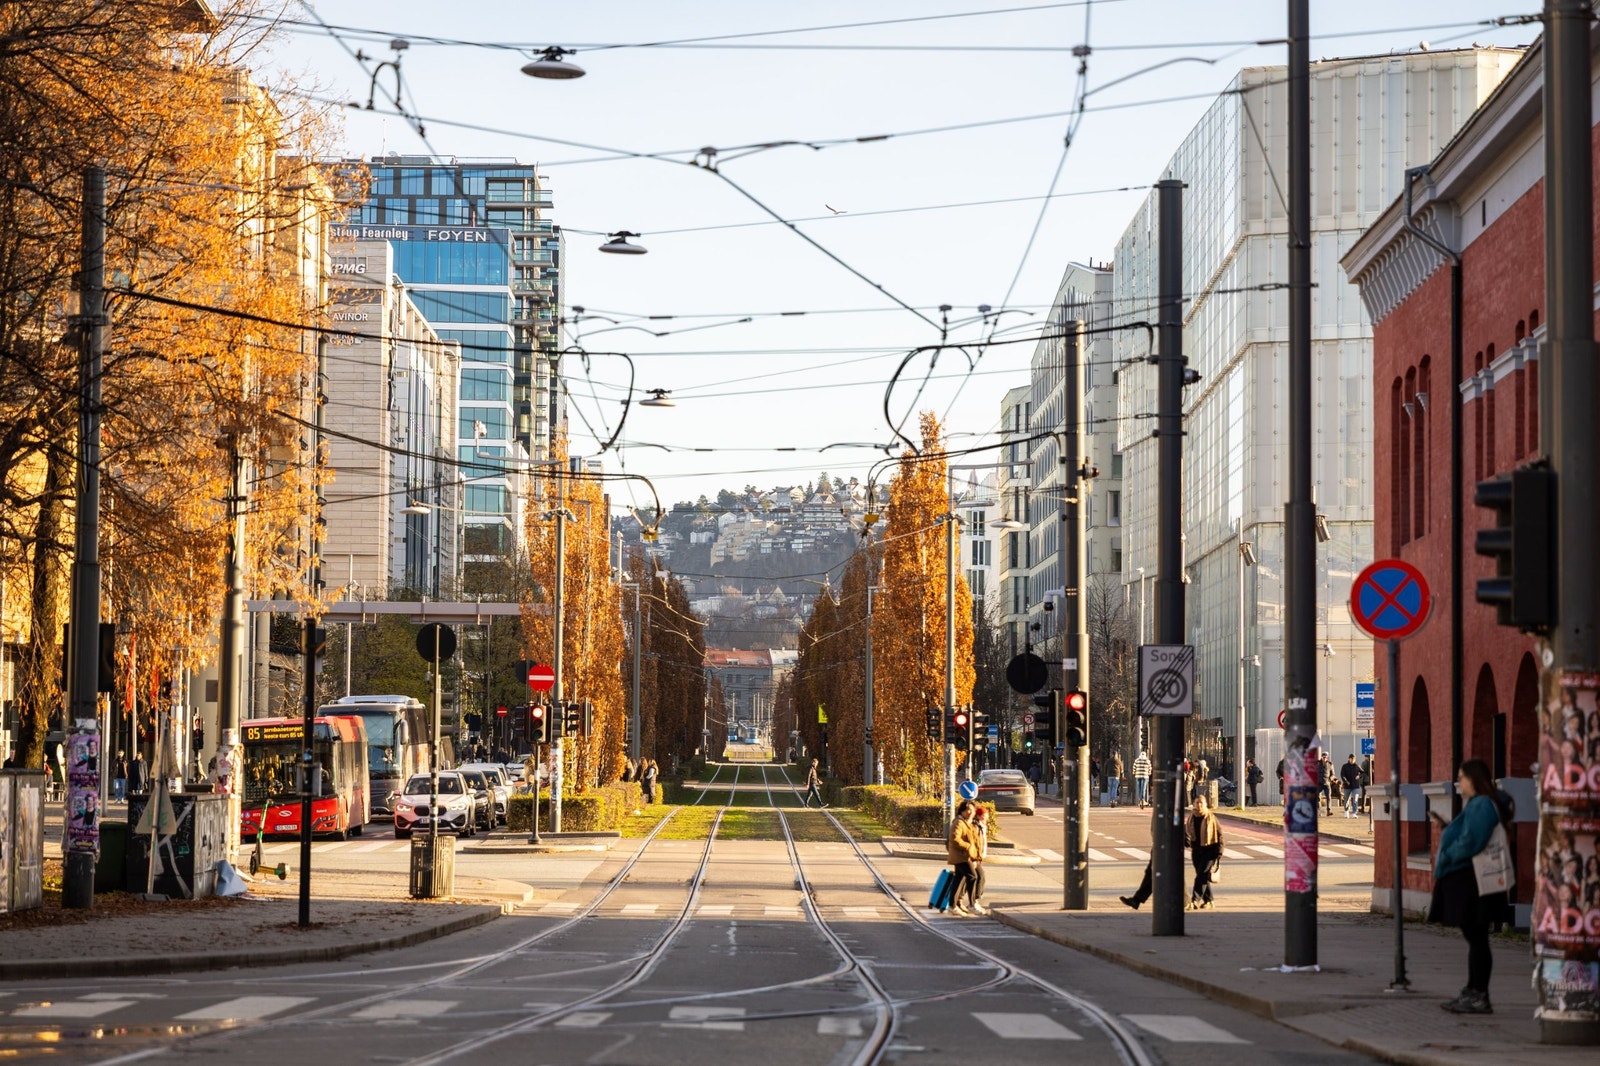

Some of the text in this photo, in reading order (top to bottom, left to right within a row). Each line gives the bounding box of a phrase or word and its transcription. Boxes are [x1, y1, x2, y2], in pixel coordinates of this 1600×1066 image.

[362, 227, 409, 241] Fearnley
[428, 230, 487, 242] FØYEN
[332, 313, 369, 321] AVINOR
[1150, 649, 1185, 662] Sone
[1155, 678, 1180, 698] 30
[247, 727, 260, 740] 85
